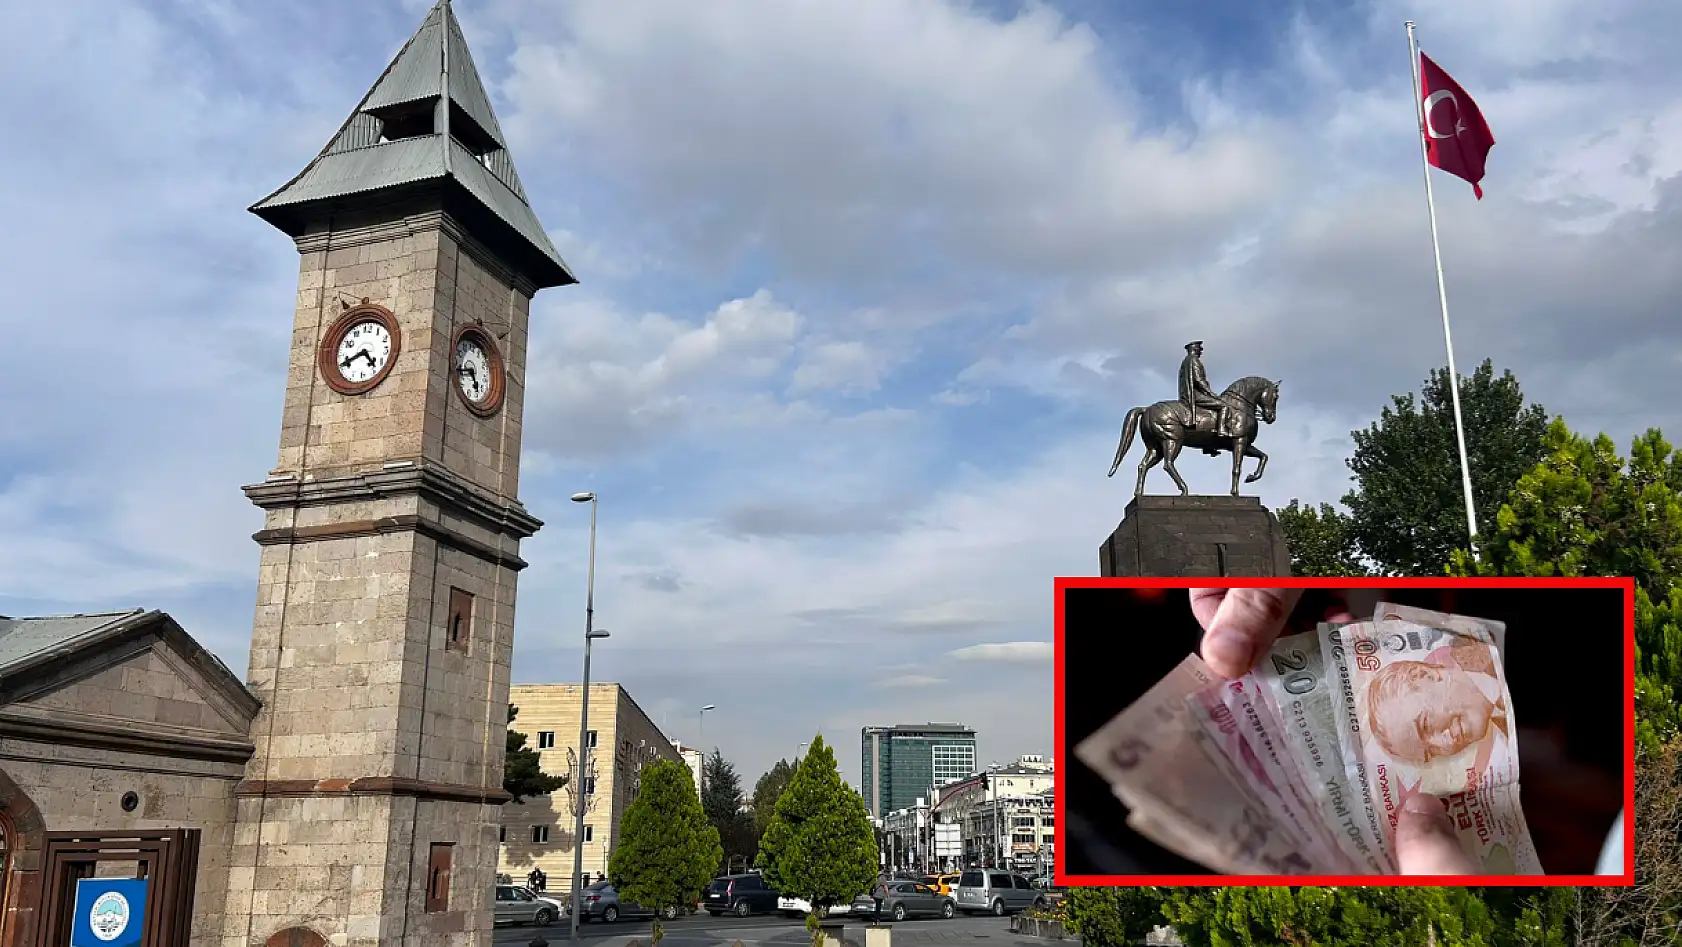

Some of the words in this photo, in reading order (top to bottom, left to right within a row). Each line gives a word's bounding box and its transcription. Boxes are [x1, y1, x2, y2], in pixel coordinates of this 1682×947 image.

[1270, 649, 1319, 695] 20
[1354, 639, 1382, 672] 50
[1377, 764, 1394, 812] BANKASI
